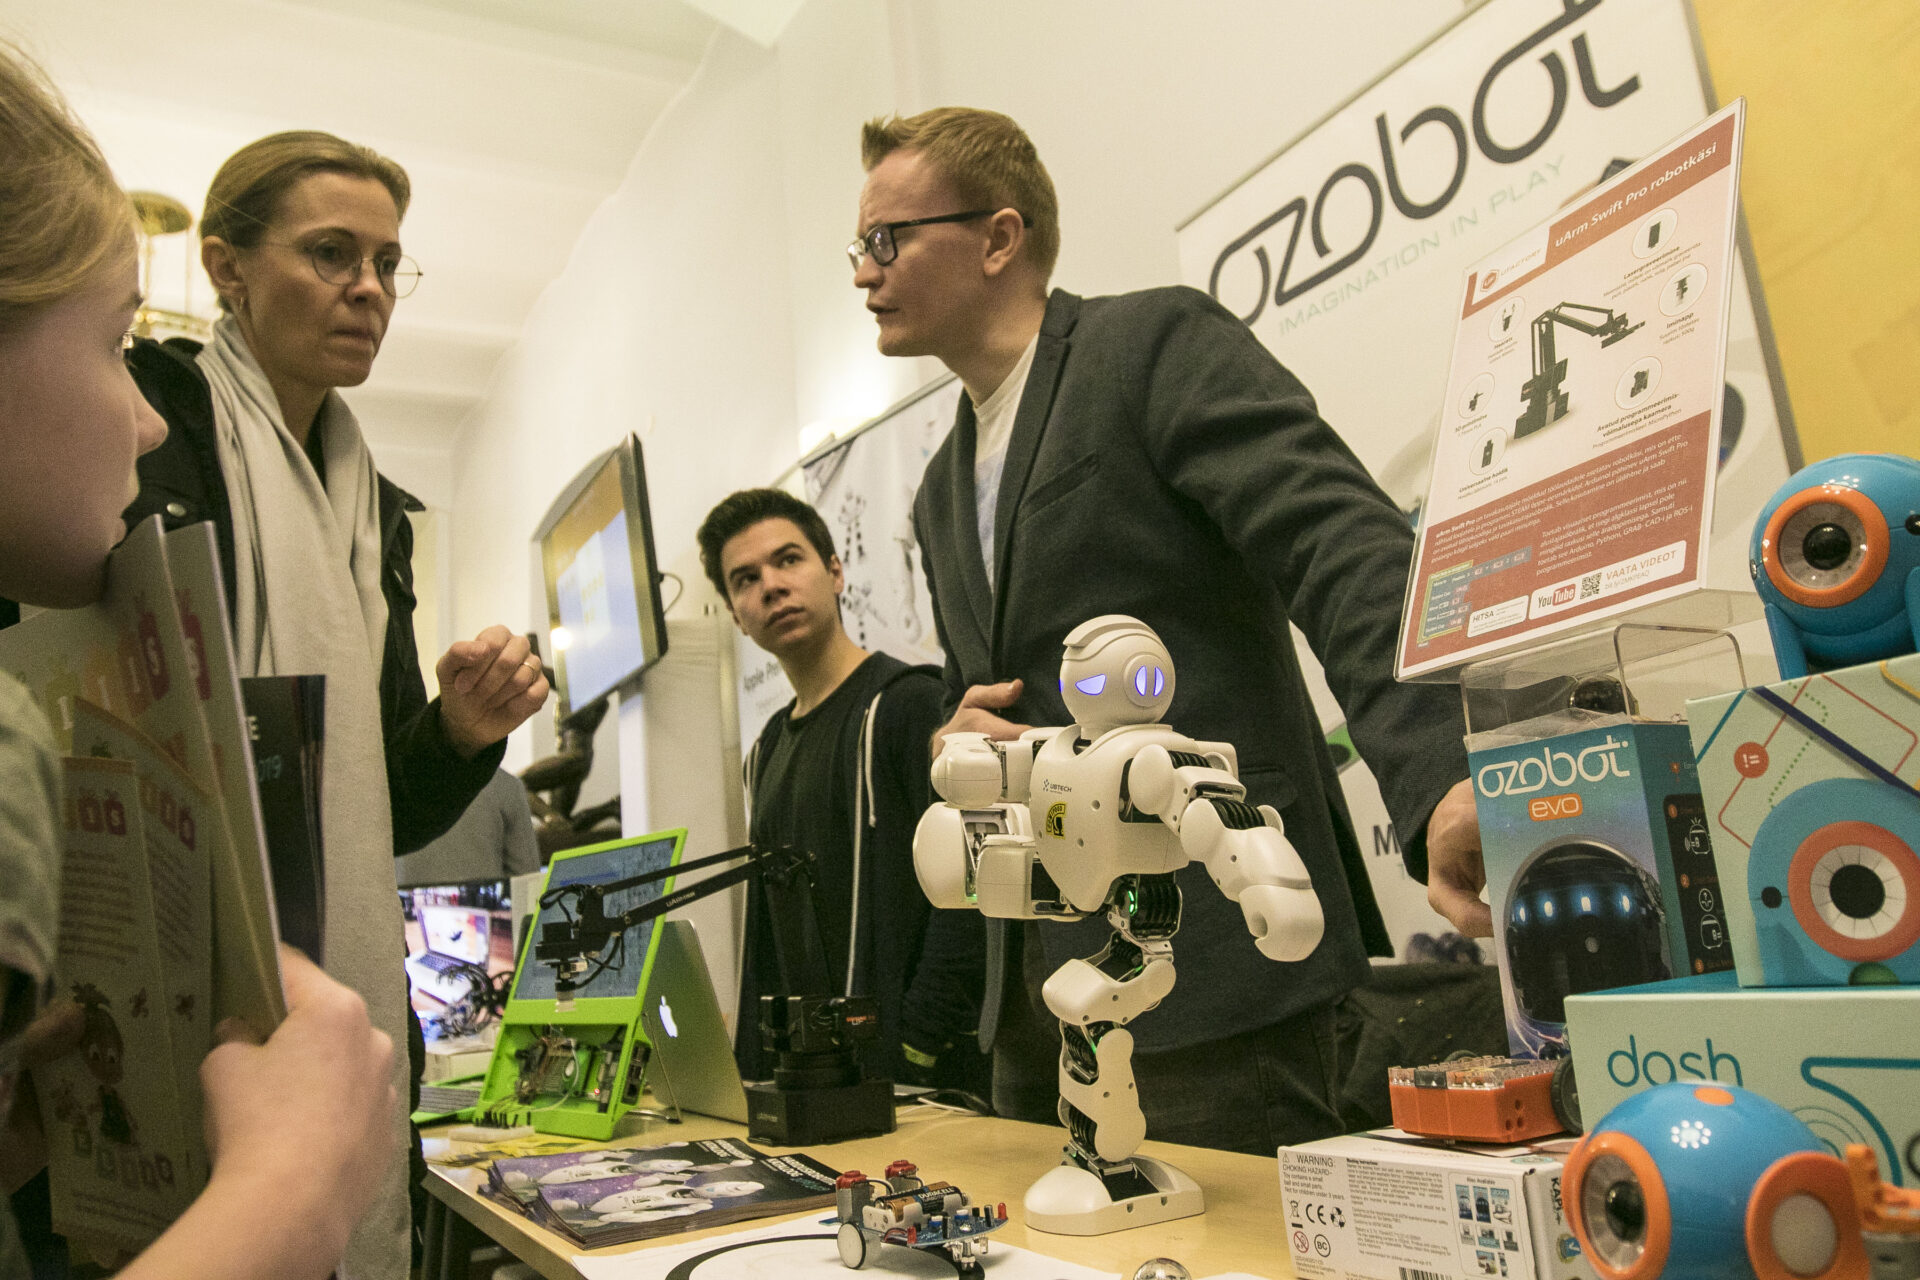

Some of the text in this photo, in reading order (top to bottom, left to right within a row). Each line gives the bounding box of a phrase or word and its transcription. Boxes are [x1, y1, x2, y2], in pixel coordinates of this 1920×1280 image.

[1554, 140, 1717, 248] uArm Swift Pro robotkäsi
[1279, 156, 1568, 337] IMAGINATION IN PLAY
[1605, 549, 1676, 581] VAATA VIDEOT
[1472, 610, 1494, 623] HITSA
[1477, 734, 1631, 798] ozobot
[1531, 794, 1580, 818] evo
